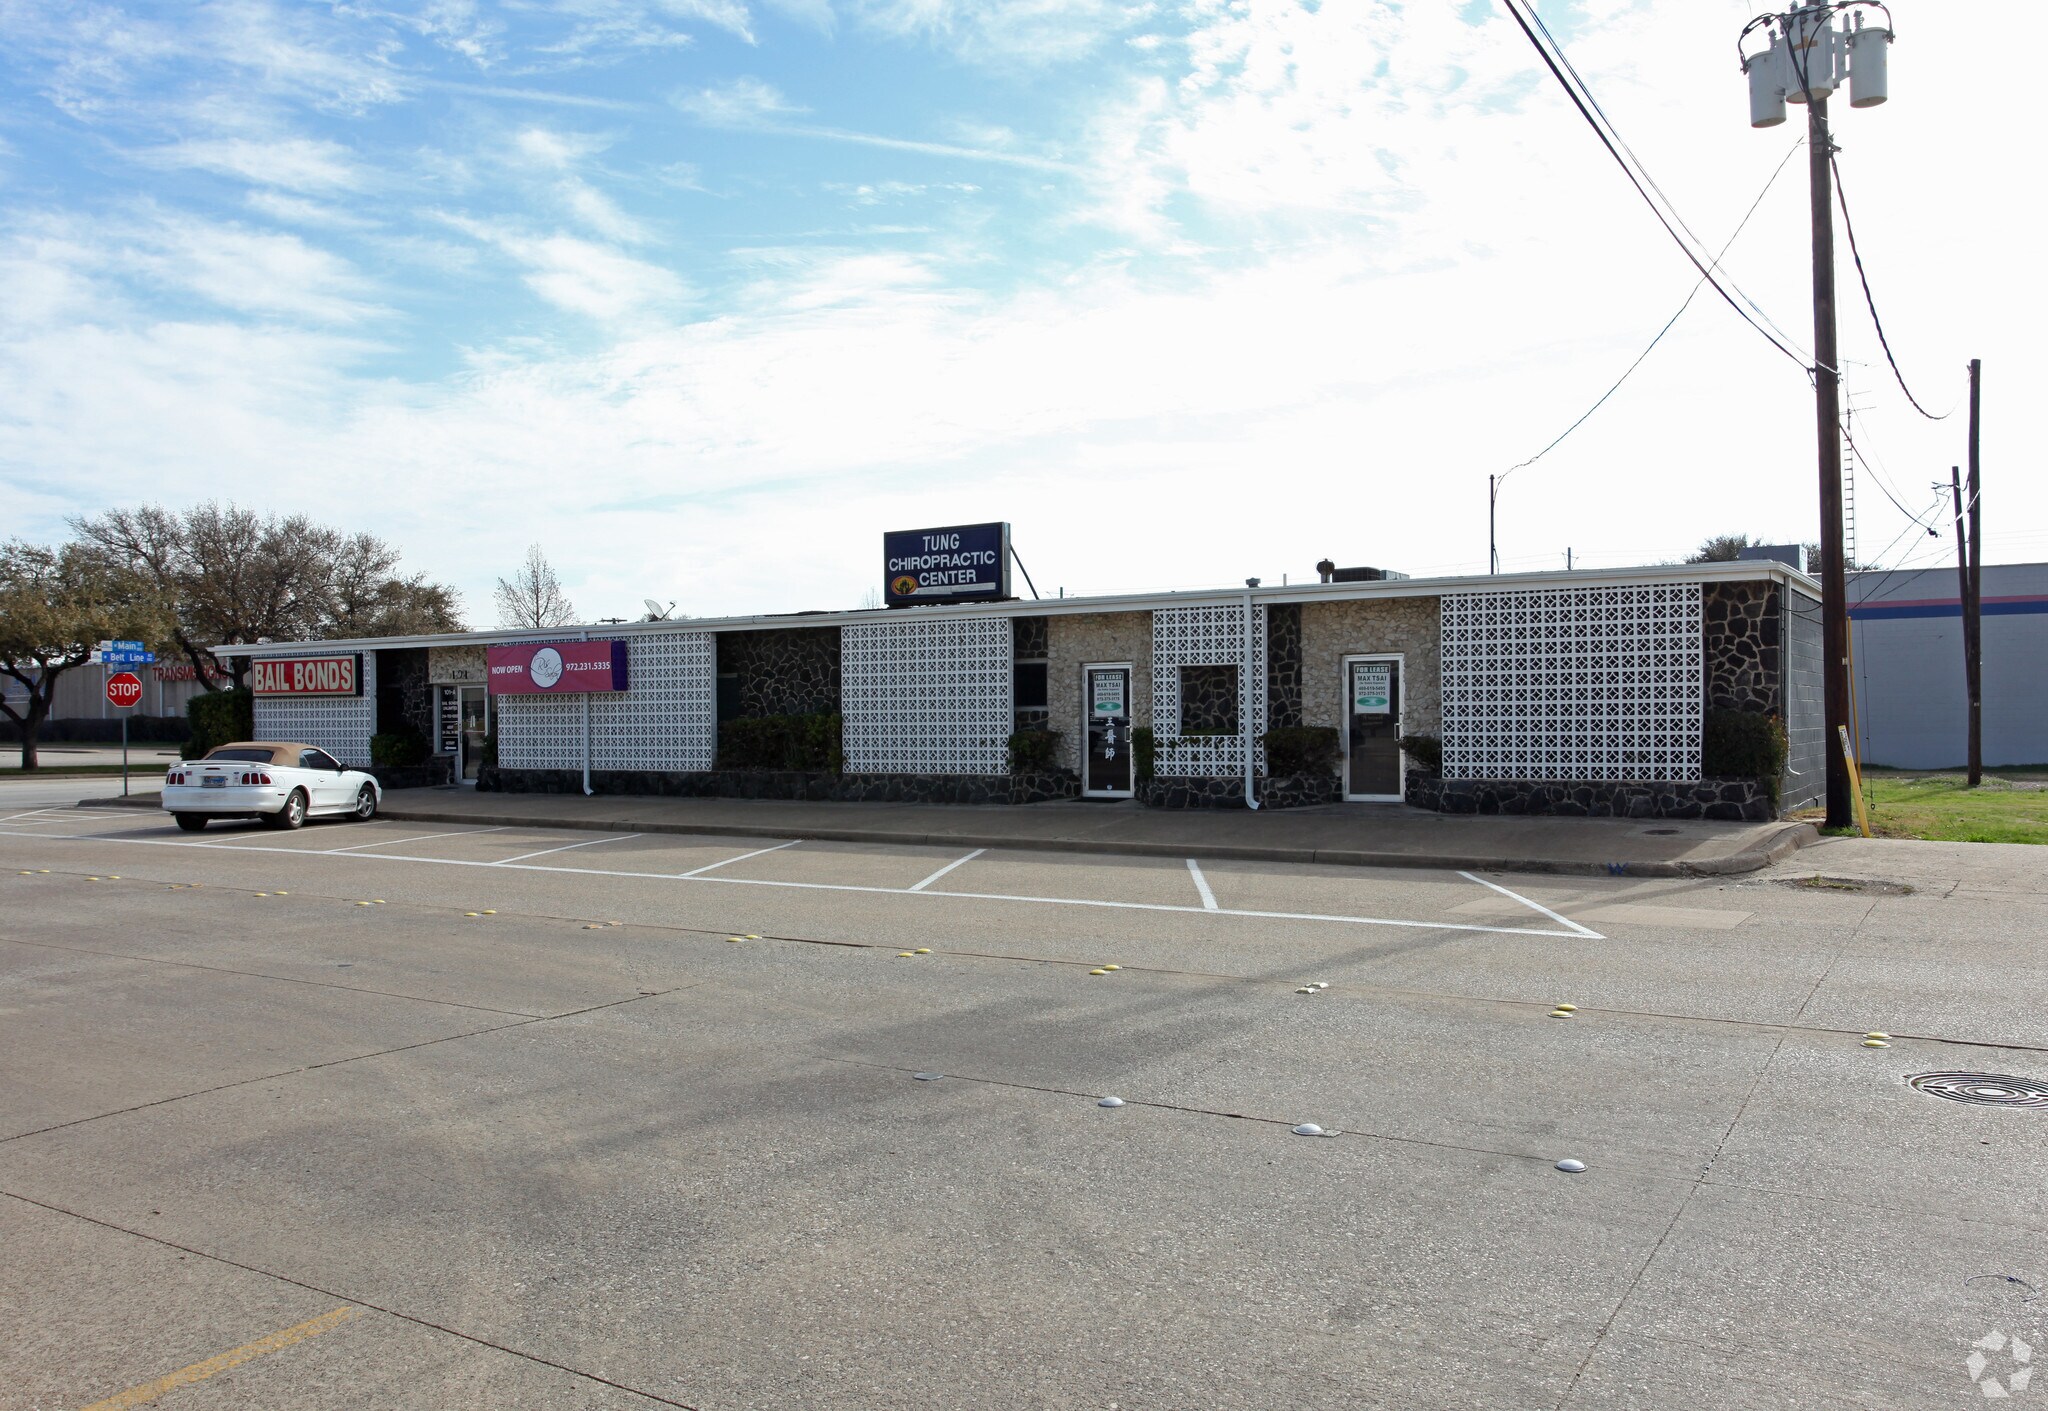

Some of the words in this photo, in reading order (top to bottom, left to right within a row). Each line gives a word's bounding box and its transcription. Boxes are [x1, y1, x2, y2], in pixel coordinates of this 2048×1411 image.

[923, 533, 960, 552] TUNG
[889, 550, 995, 571] CHIROPRACTIC
[919, 569, 976, 586] CENTER
[117, 642, 136, 650] Main
[110, 653, 125, 662] Belt
[129, 653, 145, 662] Line
[152, 664, 228, 681] TRANSMISIONS
[492, 666, 506, 675] NOW
[506, 665, 523, 674] OPEN
[566, 661, 611, 671] 972.231.5335
[254, 663, 290, 691] BAIL
[294, 660, 351, 691] BONDS
[109, 683, 140, 696] STOP
